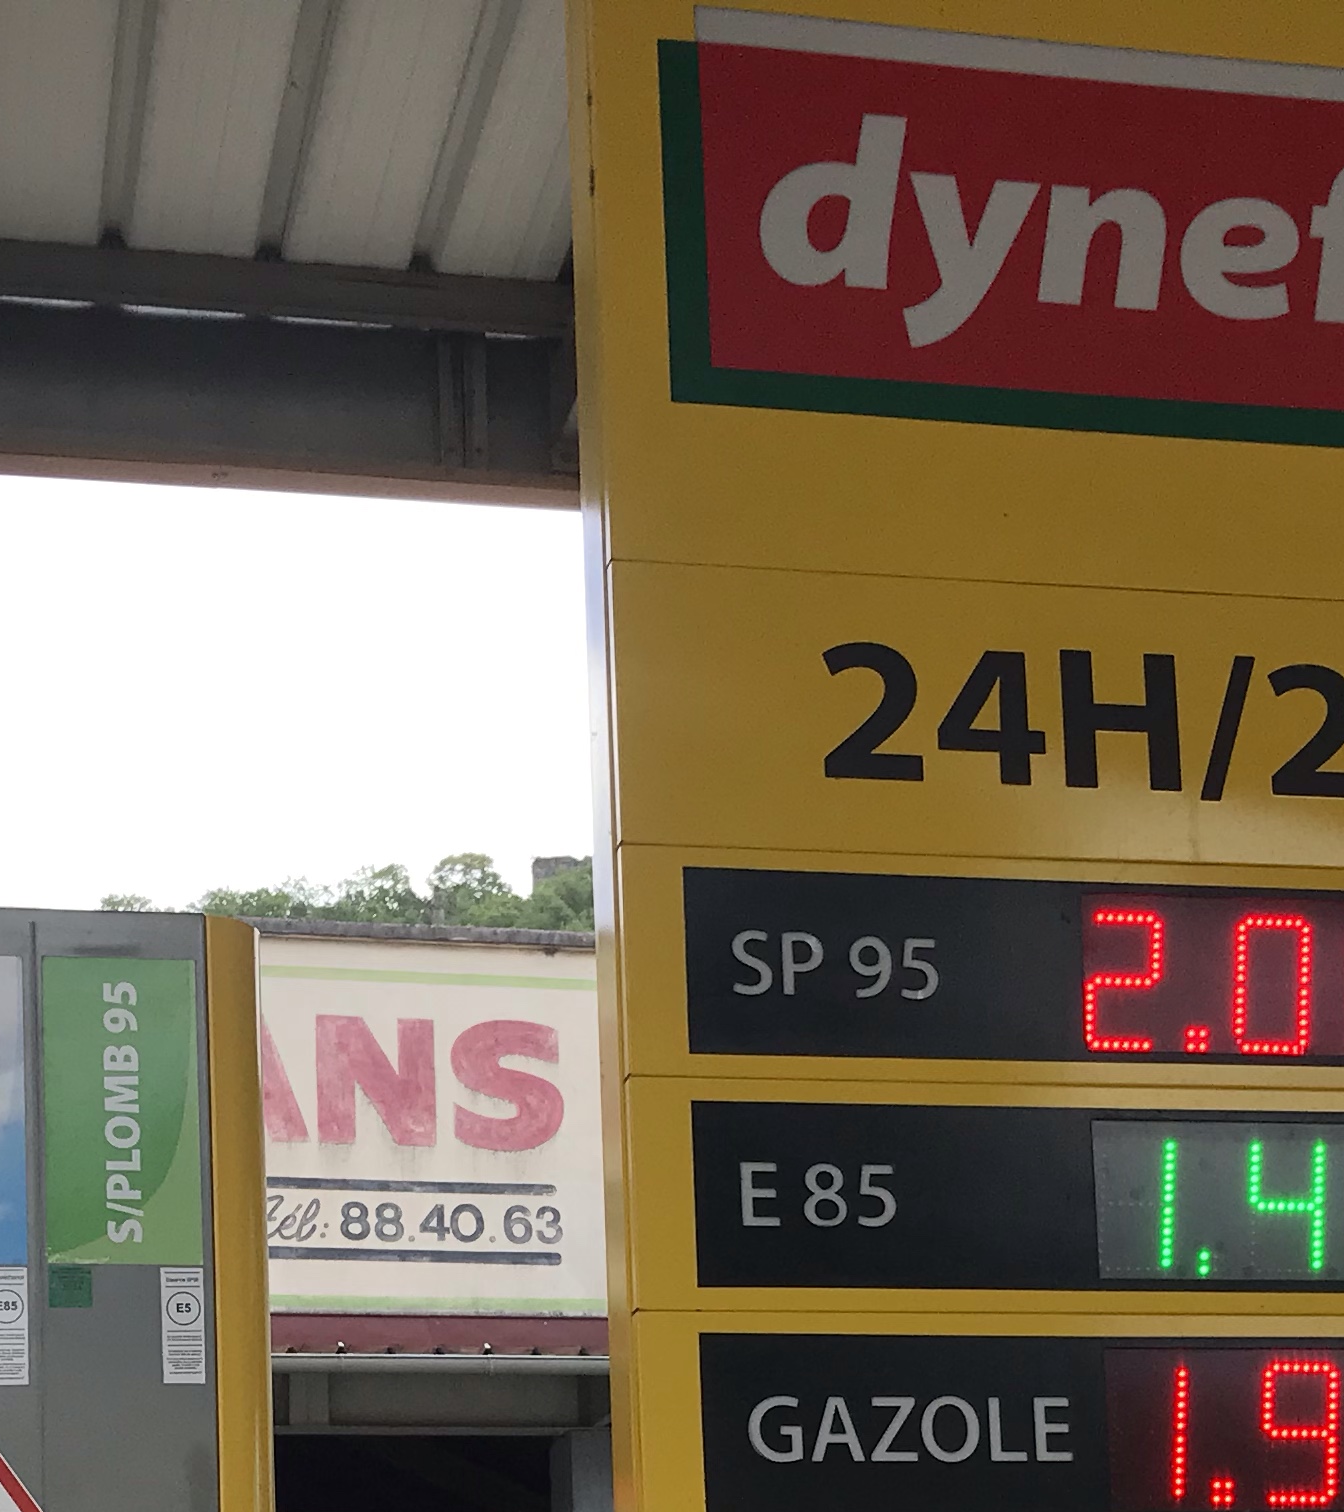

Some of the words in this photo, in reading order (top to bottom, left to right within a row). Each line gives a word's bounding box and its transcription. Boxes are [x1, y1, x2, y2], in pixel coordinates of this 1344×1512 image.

[731, 929, 824, 996] SP
[849, 934, 941, 1000] 95
[103, 980, 138, 1034] 95
[102, 1046, 145, 1244] S/PLOMB
[340, 1202, 563, 1244] 88.40.63
[740, 1161, 781, 1227] E
[804, 1163, 899, 1229] 85
[176, 1303, 191, 1313] E5
[748, 1395, 1074, 1465] GAZOLE
